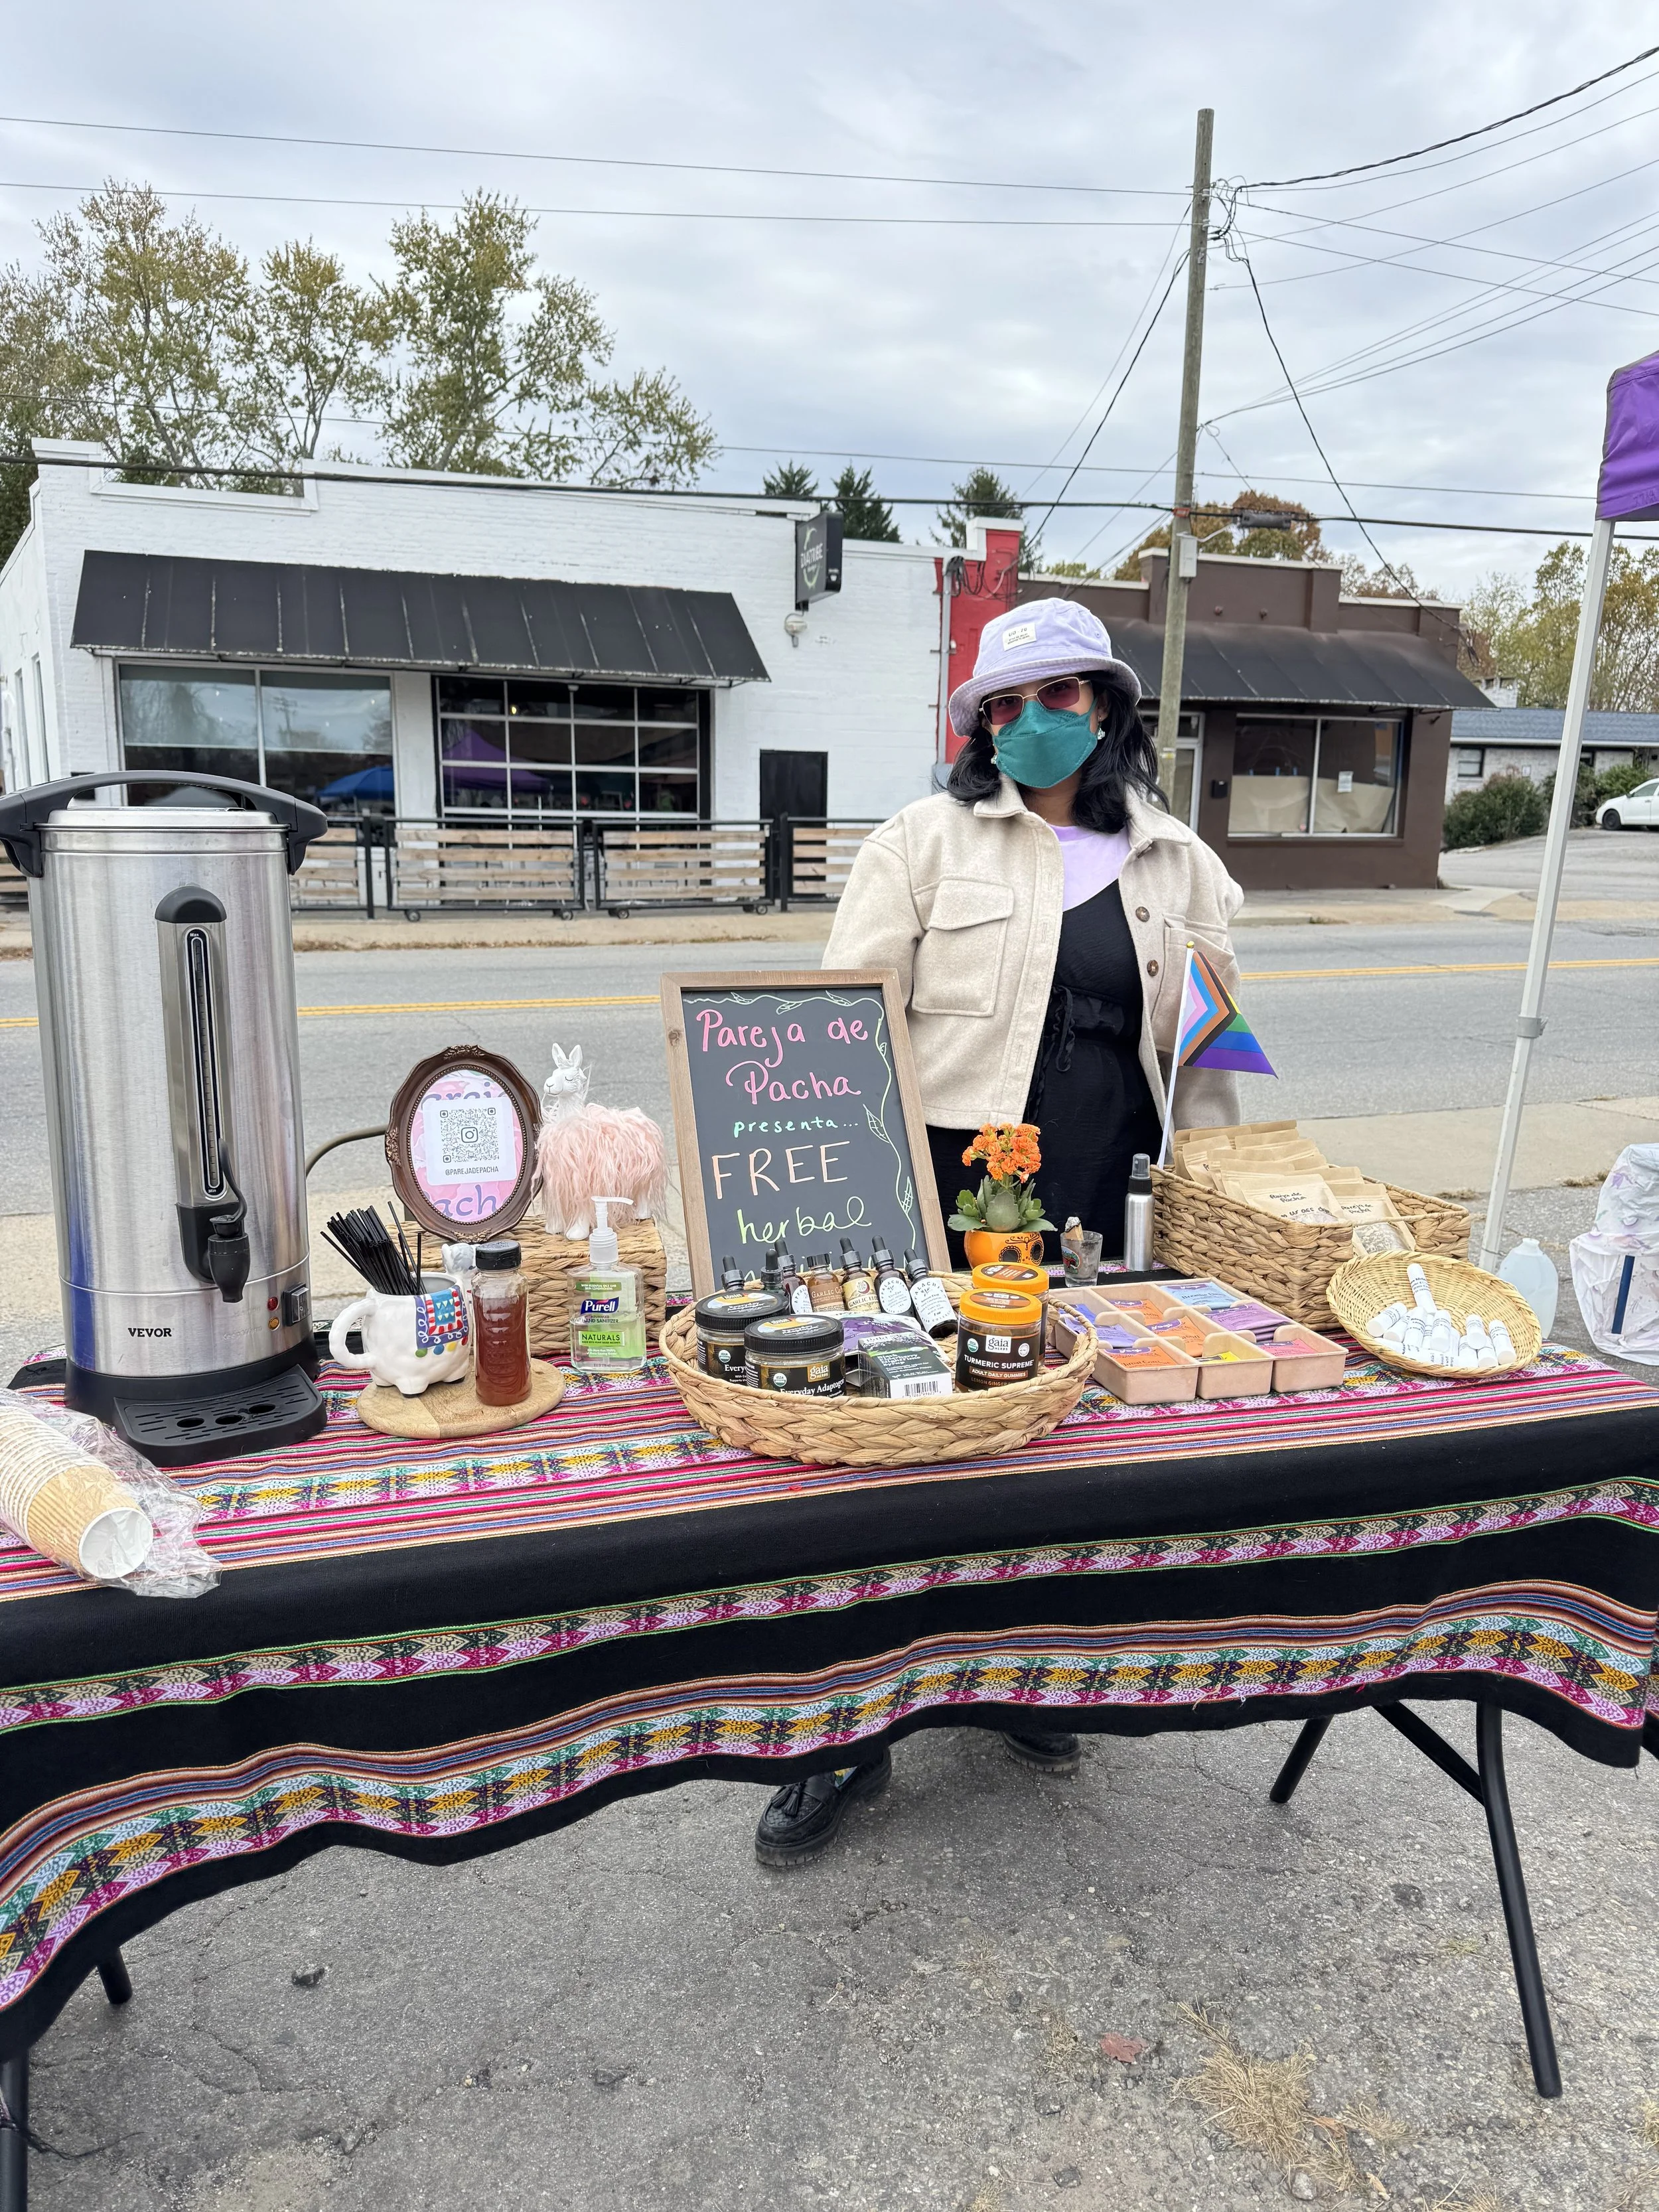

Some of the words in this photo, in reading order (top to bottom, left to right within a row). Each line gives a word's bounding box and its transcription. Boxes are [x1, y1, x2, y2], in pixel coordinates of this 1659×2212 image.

[696, 1009, 806, 1068] Pareja
[828, 1017, 869, 1044] de
[725, 1061, 861, 1104] Pacha
[445, 1166, 498, 1175] @PAREJADEPACHA
[712, 1141, 850, 1199] FREE
[737, 1196, 872, 1244] herbal
[812, 1290, 834, 1298] GARLIC
[585, 1300, 616, 1311] Purell
[849, 1297, 868, 1307] GARLIC
[128, 1328, 172, 1337] VEVOR
[988, 1338, 1009, 1350] gaia
[964, 1355, 999, 1368] TURMERIC
[1001, 1360, 1035, 1368] SUPREME
[725, 1364, 746, 1373] Every
[810, 1364, 830, 1380] gaia
